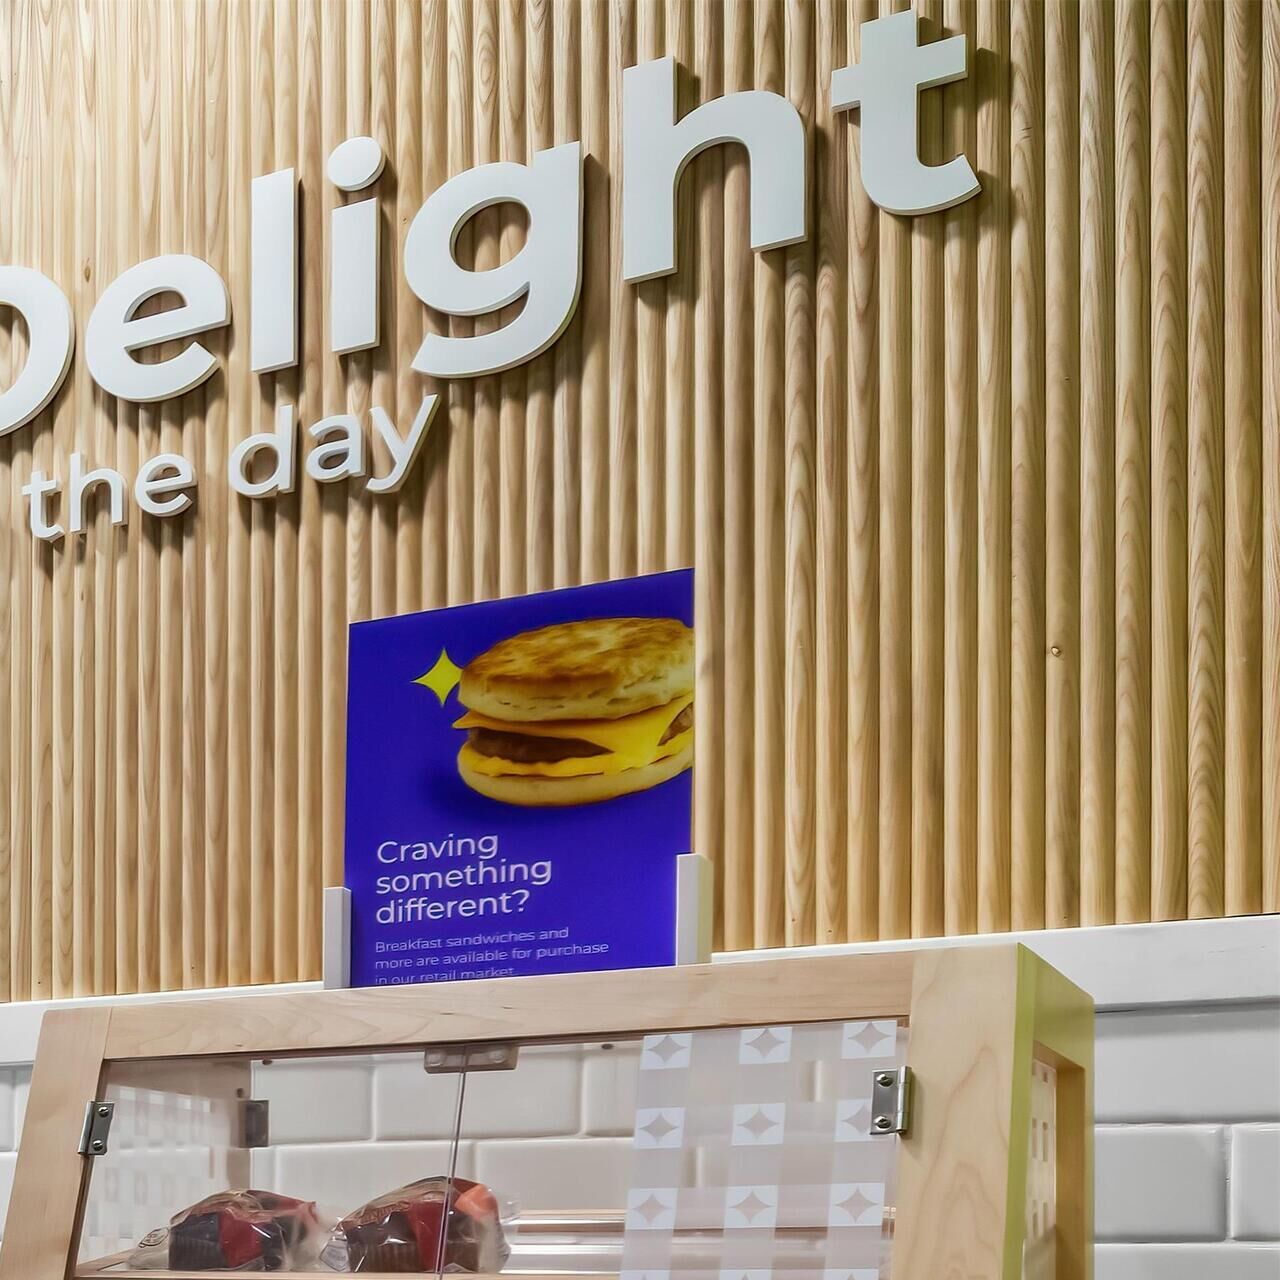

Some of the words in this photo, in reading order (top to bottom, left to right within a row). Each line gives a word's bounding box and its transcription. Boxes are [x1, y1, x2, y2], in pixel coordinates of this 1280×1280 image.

[21, 452, 198, 542] the
[228, 394, 440, 500] day
[377, 833, 499, 864] Craving
[376, 858, 552, 895] something
[376, 889, 531, 924] different?
[375, 937, 442, 953] Breakfast
[446, 931, 536, 948] sandwiches
[539, 926, 570, 940] and
[375, 958, 413, 970] more
[416, 955, 439, 967] are
[443, 949, 509, 964] available
[512, 947, 533, 960] for
[536, 942, 610, 961] purchase
[375, 974, 389, 985] in
[391, 973, 416, 985] our
[419, 969, 456, 982] retail
